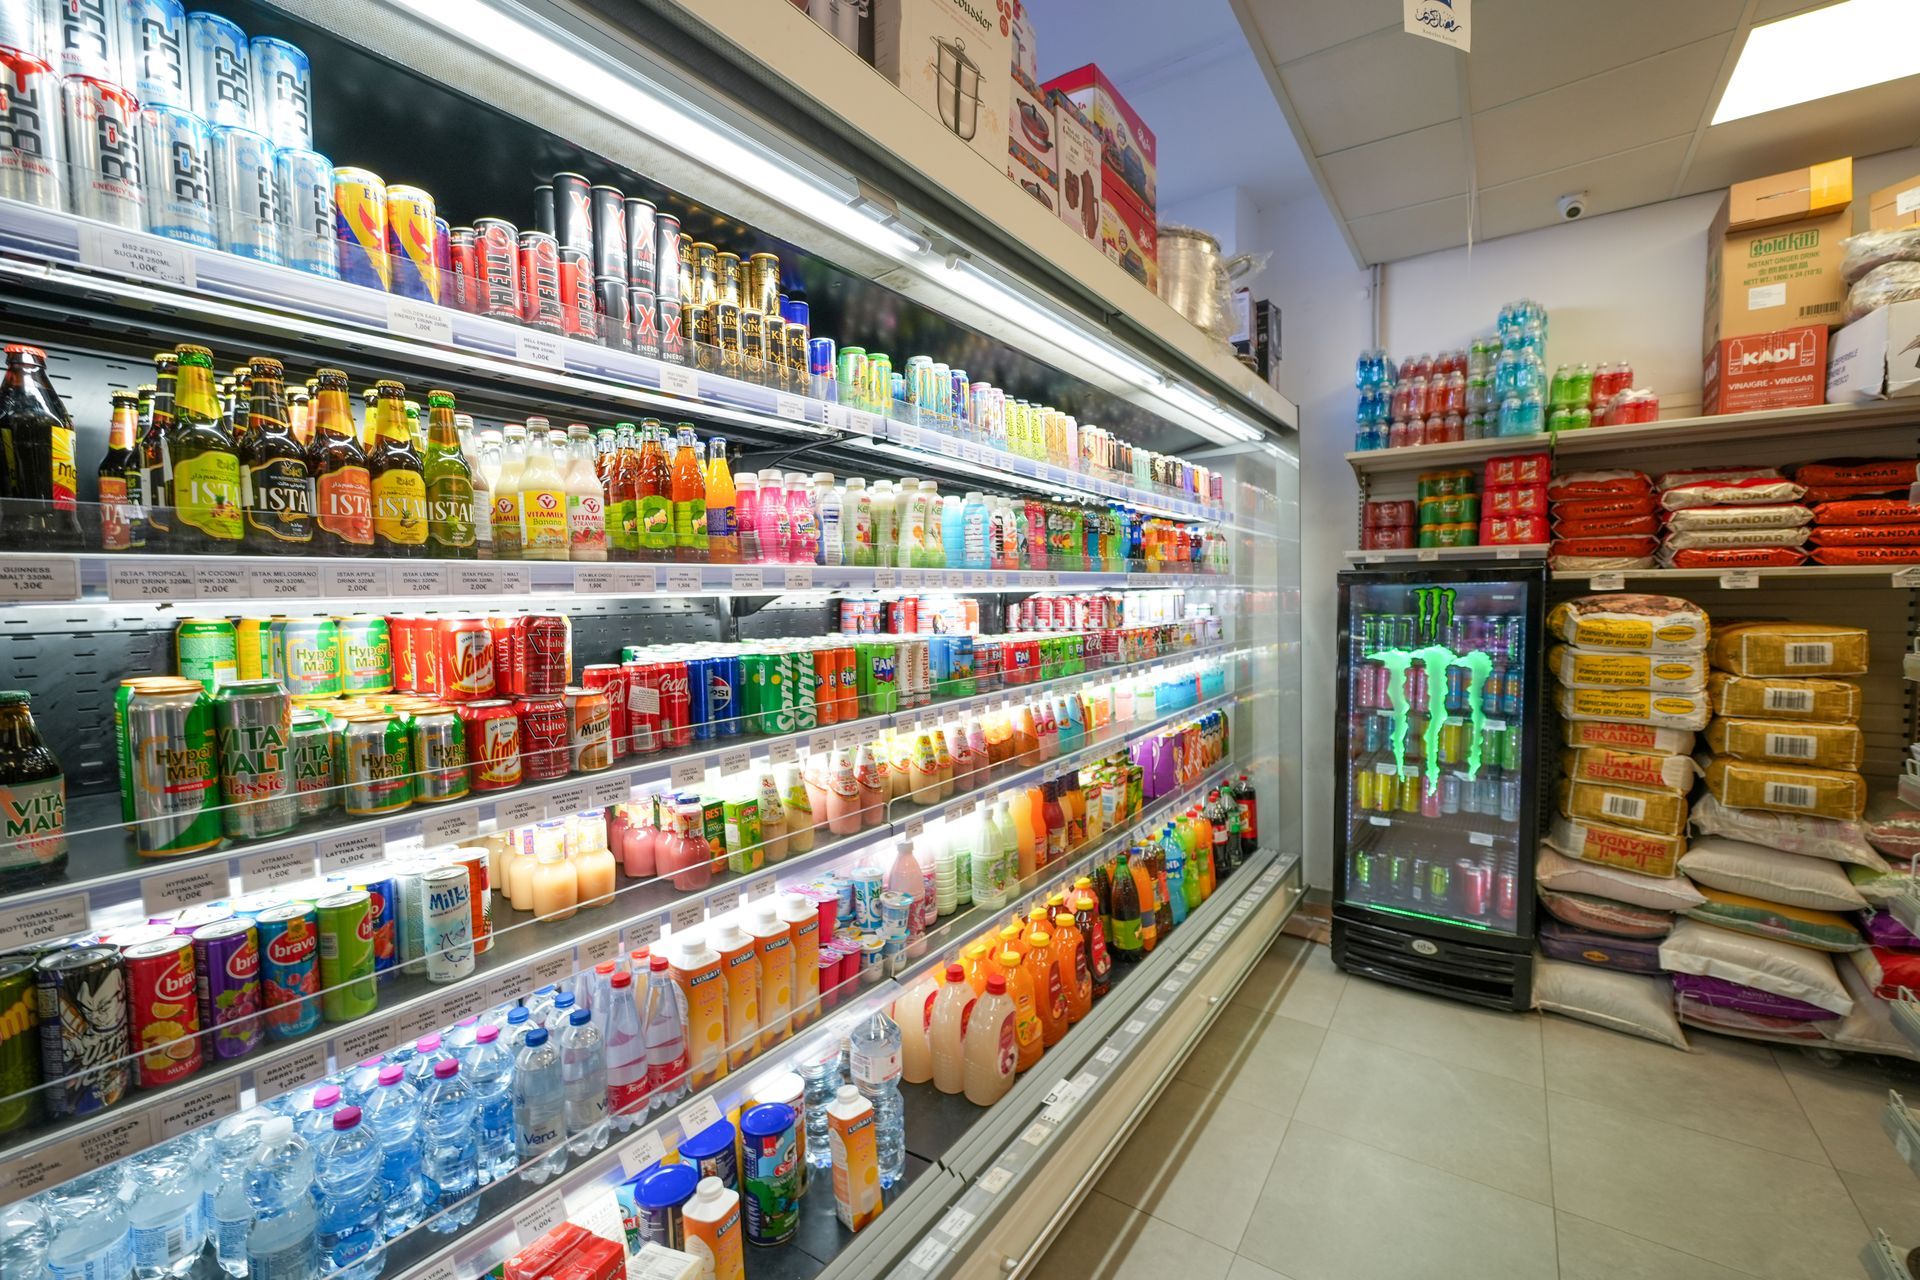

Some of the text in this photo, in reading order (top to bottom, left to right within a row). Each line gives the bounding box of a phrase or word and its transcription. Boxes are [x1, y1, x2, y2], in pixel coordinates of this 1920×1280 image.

[113, 249, 144, 261] SUGAR
[1747, 251, 1820, 269] INSTANT GINGER DRINK
[488, 250, 514, 308] HELL
[1727, 374, 1814, 391] VINAIGRE VINEGAR
[1835, 469, 1898, 478] SIKANDAR
[527, 511, 564, 519] VITAMILK
[1707, 515, 1783, 525] SIKANDAR
[533, 518, 561, 526] Banana
[1708, 534, 1784, 544] SIKANDAR
[1576, 544, 1626, 553] SIKANDAR
[1707, 554, 1770, 563] SIKANDAR
[13, 582, 43, 590] 1,30€
[142, 586, 170, 594] 2,00€
[204, 585, 229, 593] 2,00€
[274, 585, 297, 593] 2,00€
[296, 647, 336, 663] Hyper
[349, 644, 387, 661] Hyper
[498, 637, 509, 672] MALTA
[515, 636, 525, 672] MALTA
[303, 660, 334, 672] Malt
[356, 656, 384, 668] Malt
[1613, 677, 1645, 685] Semola
[776, 651, 796, 732] Sprite
[796, 650, 818, 731] Sprite
[1613, 709, 1644, 717] Semola
[156, 745, 213, 767] Hyper
[361, 749, 407, 768] Hyper
[167, 761, 211, 781] Malt
[370, 763, 403, 781] Malt
[570, 789, 584, 797] MALT
[705, 807, 723, 820] BEST
[443, 816, 461, 826] HYPER
[437, 824, 451, 832] MALT
[335, 837, 368, 849] VITAMALT
[260, 853, 294, 865] VITAMALT
[325, 847, 354, 858] LATTINA
[251, 863, 279, 875] LATTINA
[165, 872, 209, 888] HYPERMALT
[161, 885, 189, 897] LATTINA
[177, 891, 202, 902] 1,00€
[16, 908, 59, 922] VITAMALT
[23, 925, 56, 939] 1,00€
[275, 936, 317, 959] bravo
[464, 991, 478, 1000] MILK
[504, 987, 522, 998] 1,00€
[441, 1002, 465, 1015] YOGURT
[453, 1008, 472, 1019] 1,00€
[343, 1025, 389, 1046] BRAVO GREEN
[345, 1041, 368, 1053] APPLE
[355, 1044, 380, 1058] 1,20€
[267, 1054, 314, 1076] BRAVO SOUR
[263, 1069, 294, 1085] CHERRY
[278, 1074, 306, 1089] 1,20€
[183, 1092, 213, 1108] BRAVO
[163, 1103, 204, 1124] FRAGOLA
[183, 1109, 216, 1127] 1,20€
[523, 1130, 557, 1147] Vera
[84, 1138, 112, 1155] ULTRA
[533, 1217, 553, 1232] 1,00€
